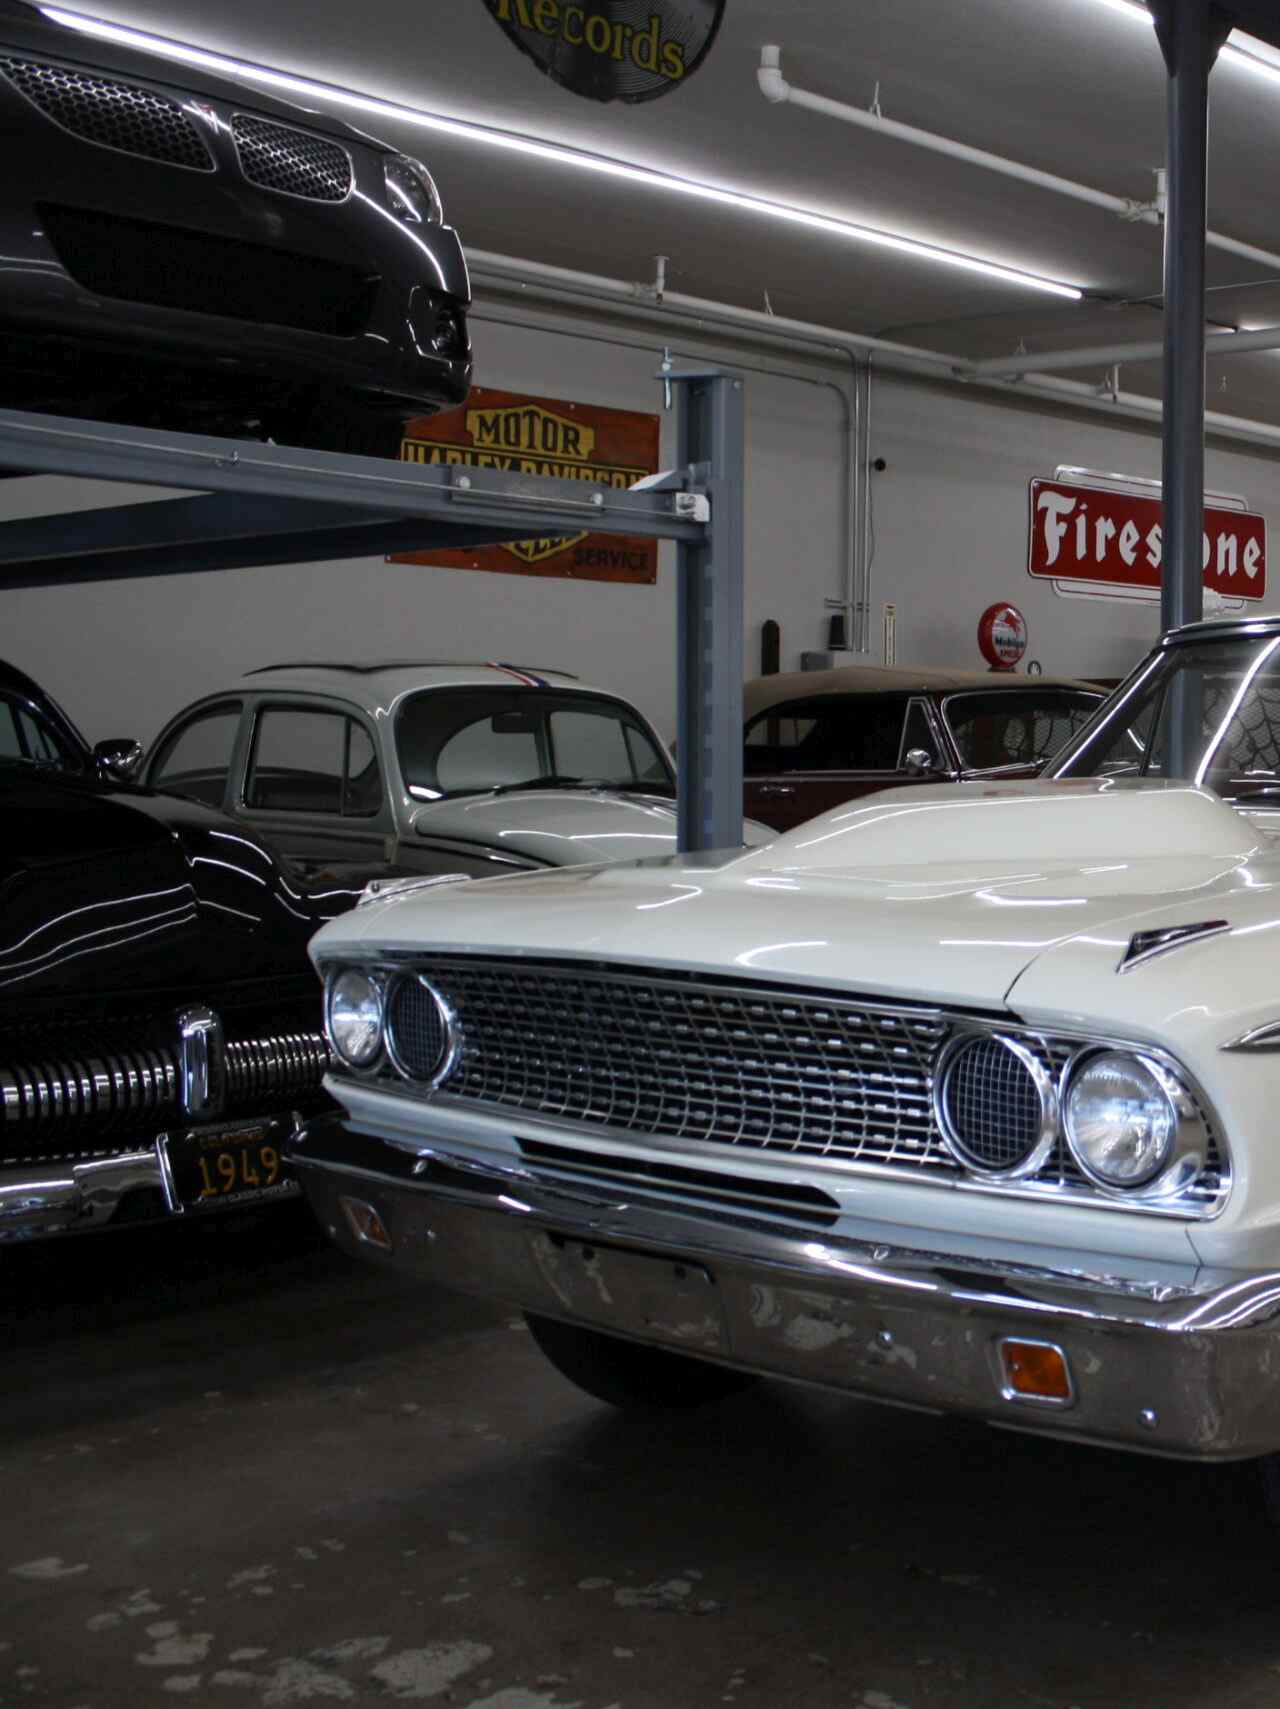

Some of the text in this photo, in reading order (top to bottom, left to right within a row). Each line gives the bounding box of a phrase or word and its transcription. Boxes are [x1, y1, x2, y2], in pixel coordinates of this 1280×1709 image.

[476, 409, 583, 457] MOTOR
[1037, 491, 1261, 579] Firesne
[198, 1146, 281, 1197] 1949
